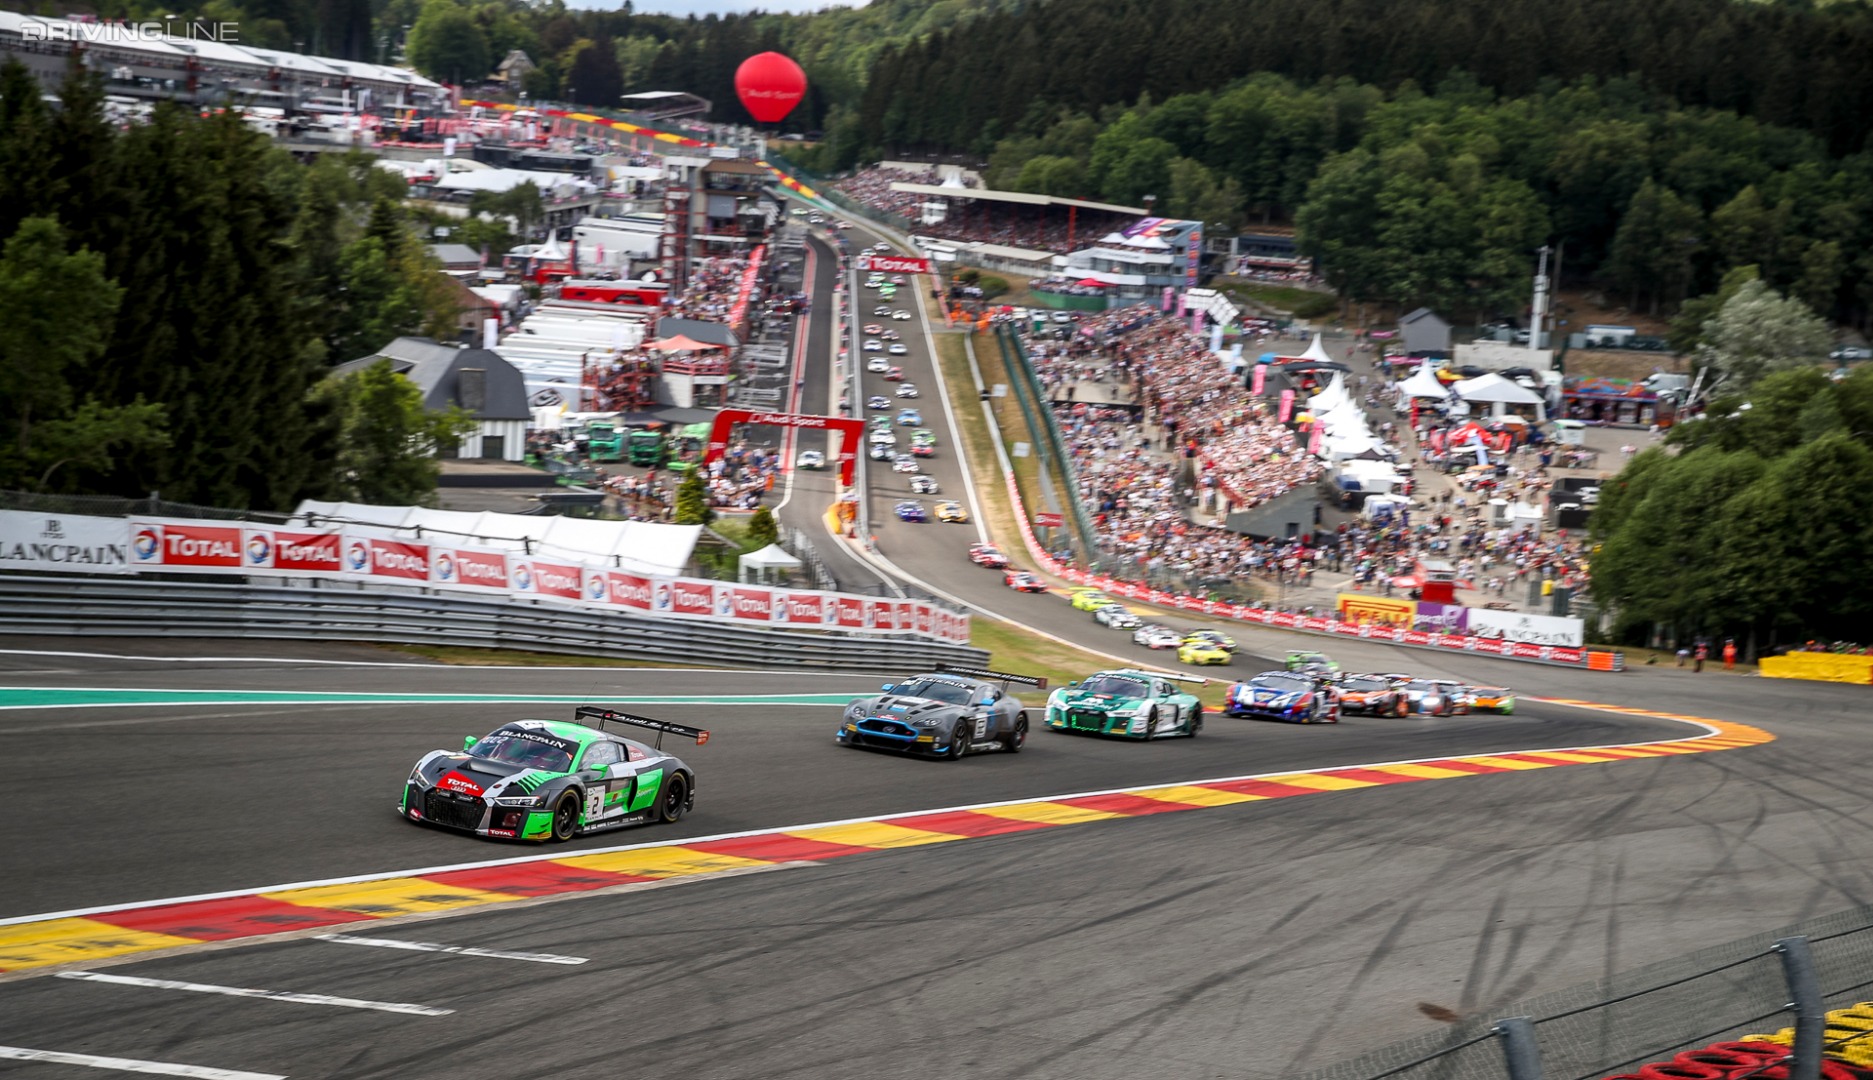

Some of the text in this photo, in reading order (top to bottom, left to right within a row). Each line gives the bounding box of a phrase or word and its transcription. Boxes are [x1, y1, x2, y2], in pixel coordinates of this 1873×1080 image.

[872, 257, 924, 272] TOTAL
[764, 414, 827, 427] Audi Sport
[166, 534, 240, 558] TOTAL
[276, 540, 340, 563] TOTAL
[373, 547, 429, 572] TOTAL
[458, 558, 506, 580] TOTAL
[534, 569, 582, 592] TOTAL
[609, 580, 652, 603] TOTAL
[674, 588, 713, 609] TOTAL
[733, 594, 771, 612] TOTAL
[788, 600, 822, 617] TOTAL
[837, 604, 864, 621] TOTAL
[1514, 646, 1540, 658] TOTAL
[1550, 651, 1580, 662] TOTAL
[499, 730, 567, 749] BLANCPAIN
[447, 778, 479, 791] TOTAL
[592, 796, 600, 815] 2
[489, 829, 513, 837] TOTAL
